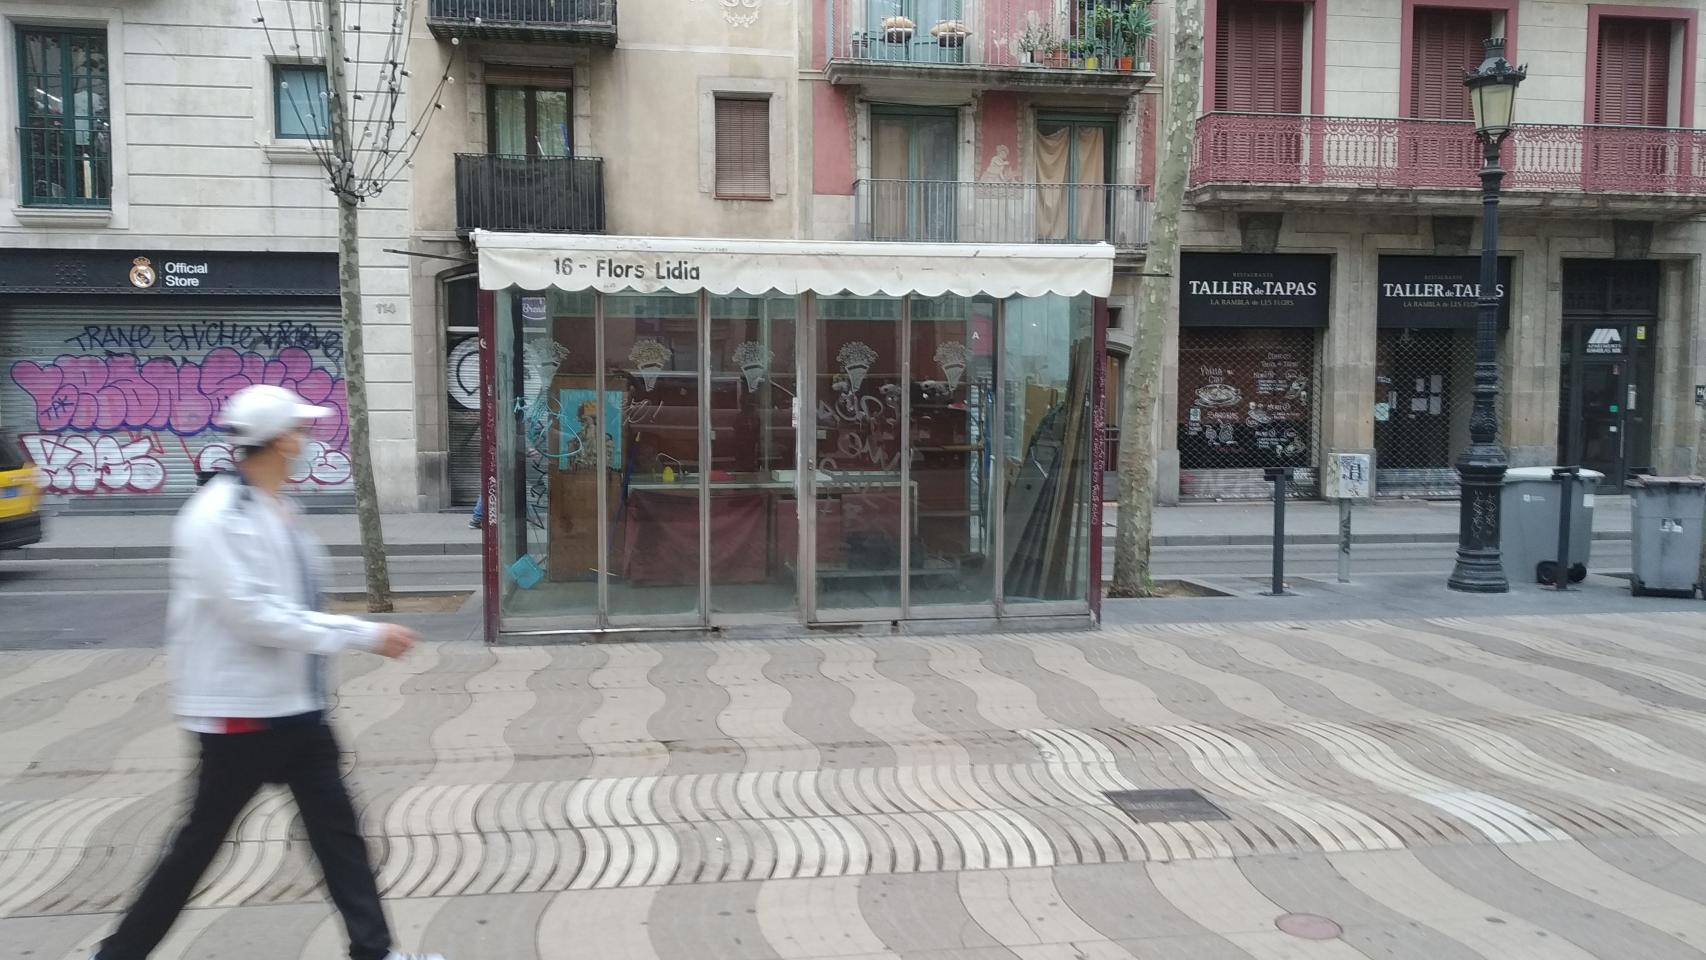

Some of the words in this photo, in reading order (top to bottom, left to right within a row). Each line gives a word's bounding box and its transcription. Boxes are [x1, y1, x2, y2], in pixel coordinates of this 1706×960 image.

[164, 262, 208, 274] Official
[554, 257, 573, 275] 16
[596, 258, 645, 279] Flors
[656, 260, 700, 280] Lidia
[165, 275, 200, 287] Store
[1453, 283, 1505, 298] TAPS
